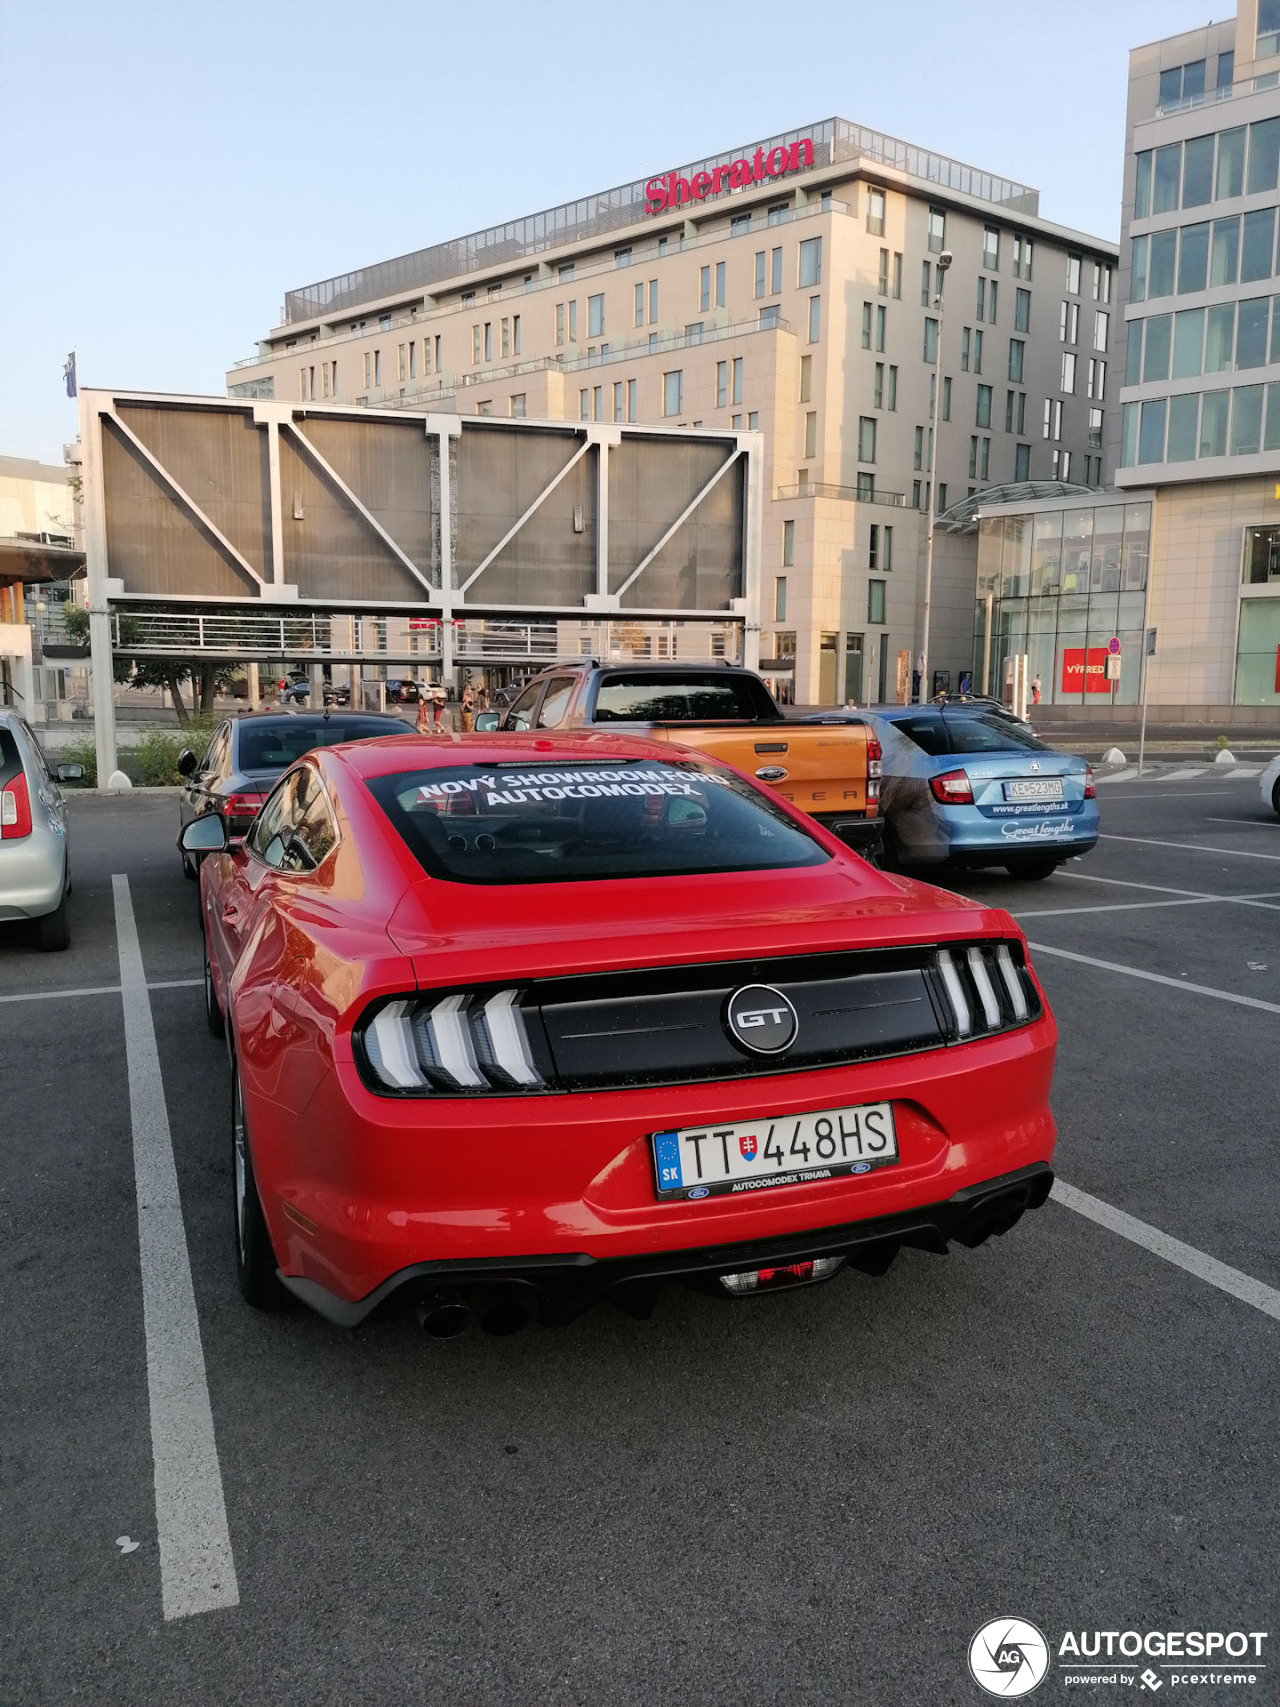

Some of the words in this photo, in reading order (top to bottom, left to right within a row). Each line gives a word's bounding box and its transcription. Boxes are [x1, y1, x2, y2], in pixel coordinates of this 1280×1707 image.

[644, 137, 815, 216] Sheraton
[418, 774, 497, 798] NOVÝ
[501, 770, 663, 788] SHOWROOM
[661, 771, 729, 785] FORD
[487, 783, 703, 806] AUTOCOMODEX
[1011, 782, 1025, 795] KE
[1029, 781, 1061, 794] 523MG
[992, 802, 1069, 814] www.greatlengths.sk
[1001, 821, 1039, 840] Great
[736, 1007, 789, 1028] GT
[685, 1130, 735, 1178] TT
[763, 1110, 887, 1167] 448HS
[662, 1167, 679, 1181] SK
[732, 1174, 798, 1192] AUTOCOMODEX
[799, 1169, 832, 1183] TRNAVA
